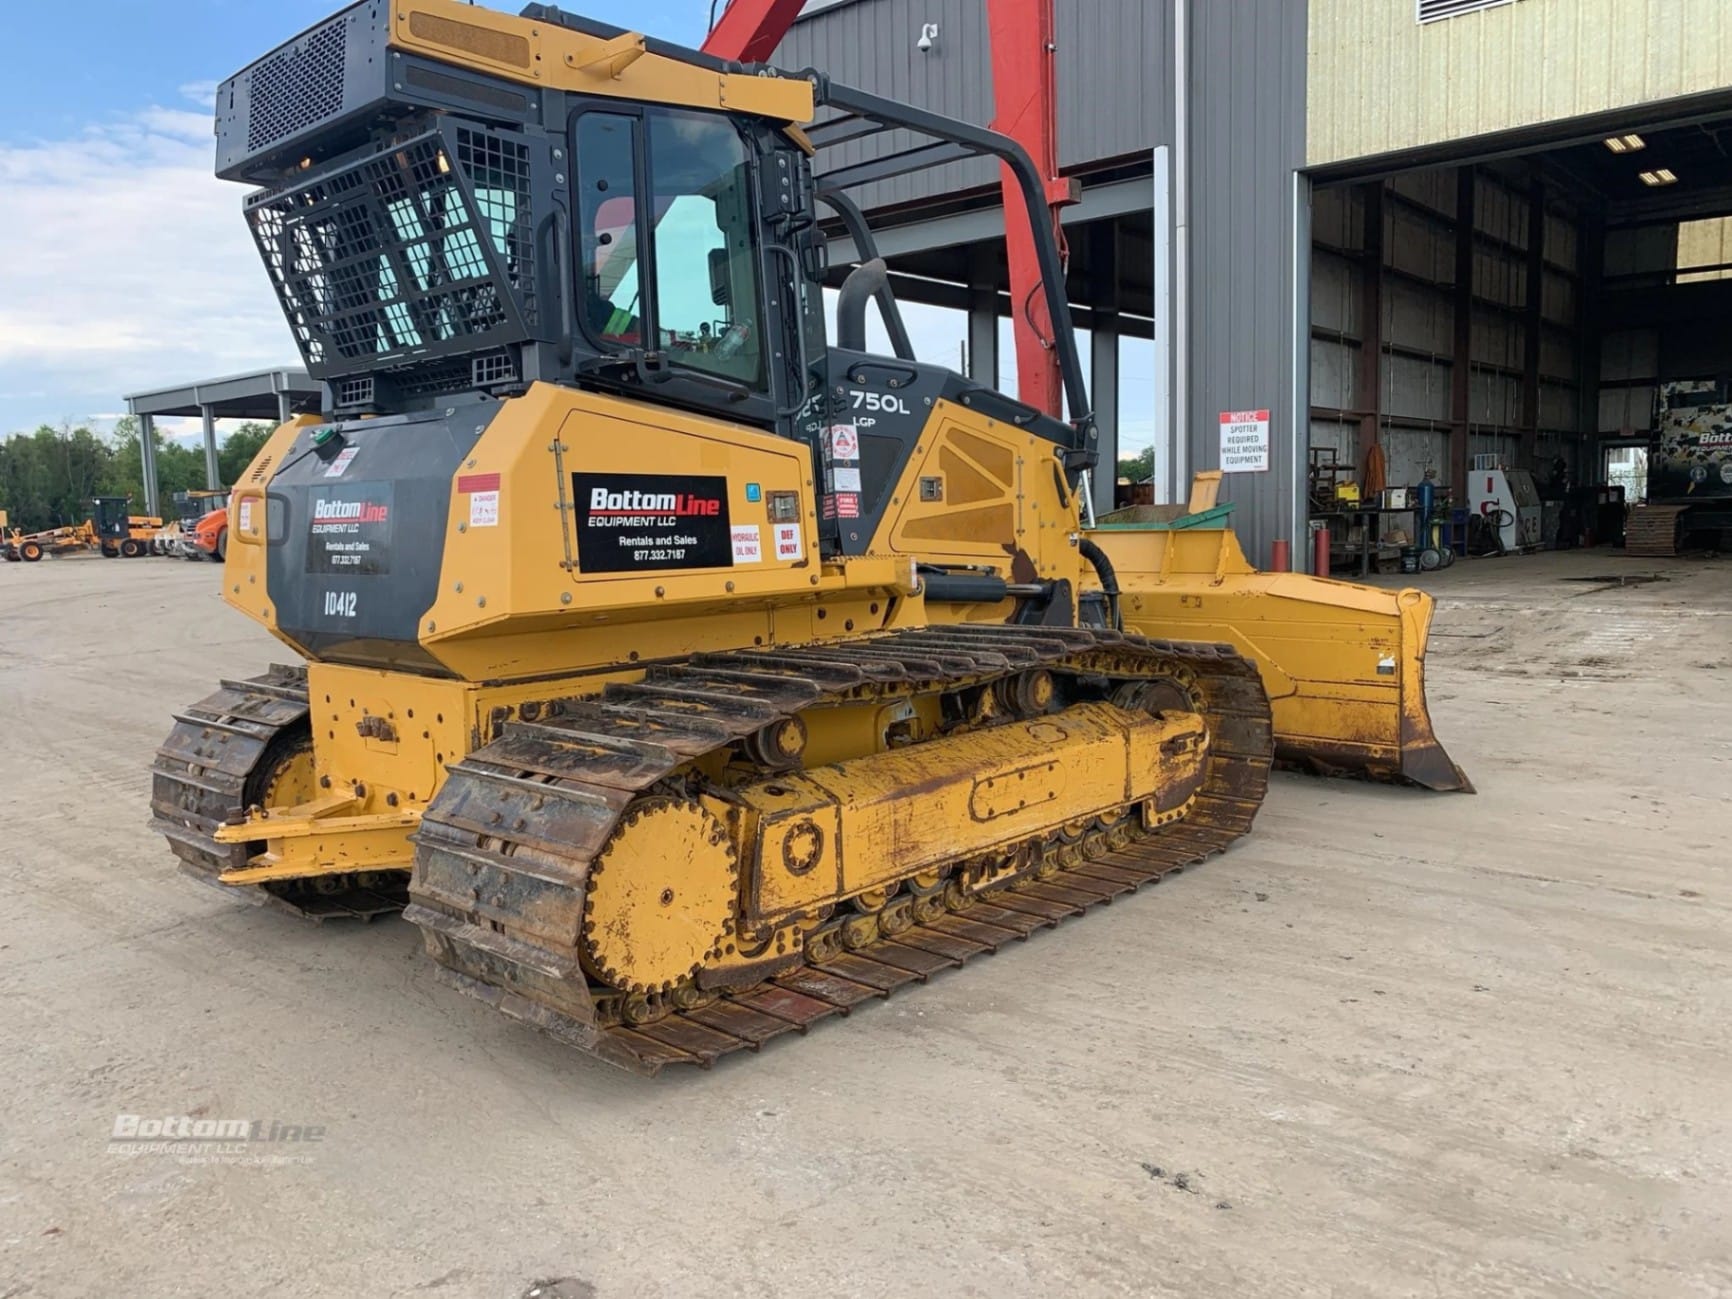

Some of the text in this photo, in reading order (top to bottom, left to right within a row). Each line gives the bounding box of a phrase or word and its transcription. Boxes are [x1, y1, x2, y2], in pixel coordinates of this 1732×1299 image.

[849, 390, 911, 415] 750L
[852, 416, 876, 427] LGP
[1230, 424, 1258, 433] SPOTTER
[1227, 435, 1259, 444] REQUIRED
[1699, 432, 1732, 443] Bott
[1222, 445, 1267, 454] WHILE MOVING
[1226, 455, 1262, 464] EQUIPMENT
[588, 516, 677, 527] EQUIPMENT LLC
[312, 523, 359, 533] EQUIPMENT LLC
[780, 530, 794, 540] DEF
[619, 535, 698, 547] Rentals and Sales
[780, 543, 797, 554] ONLY
[633, 549, 685, 561] 877.332.7187
[325, 591, 357, 617] 10412
